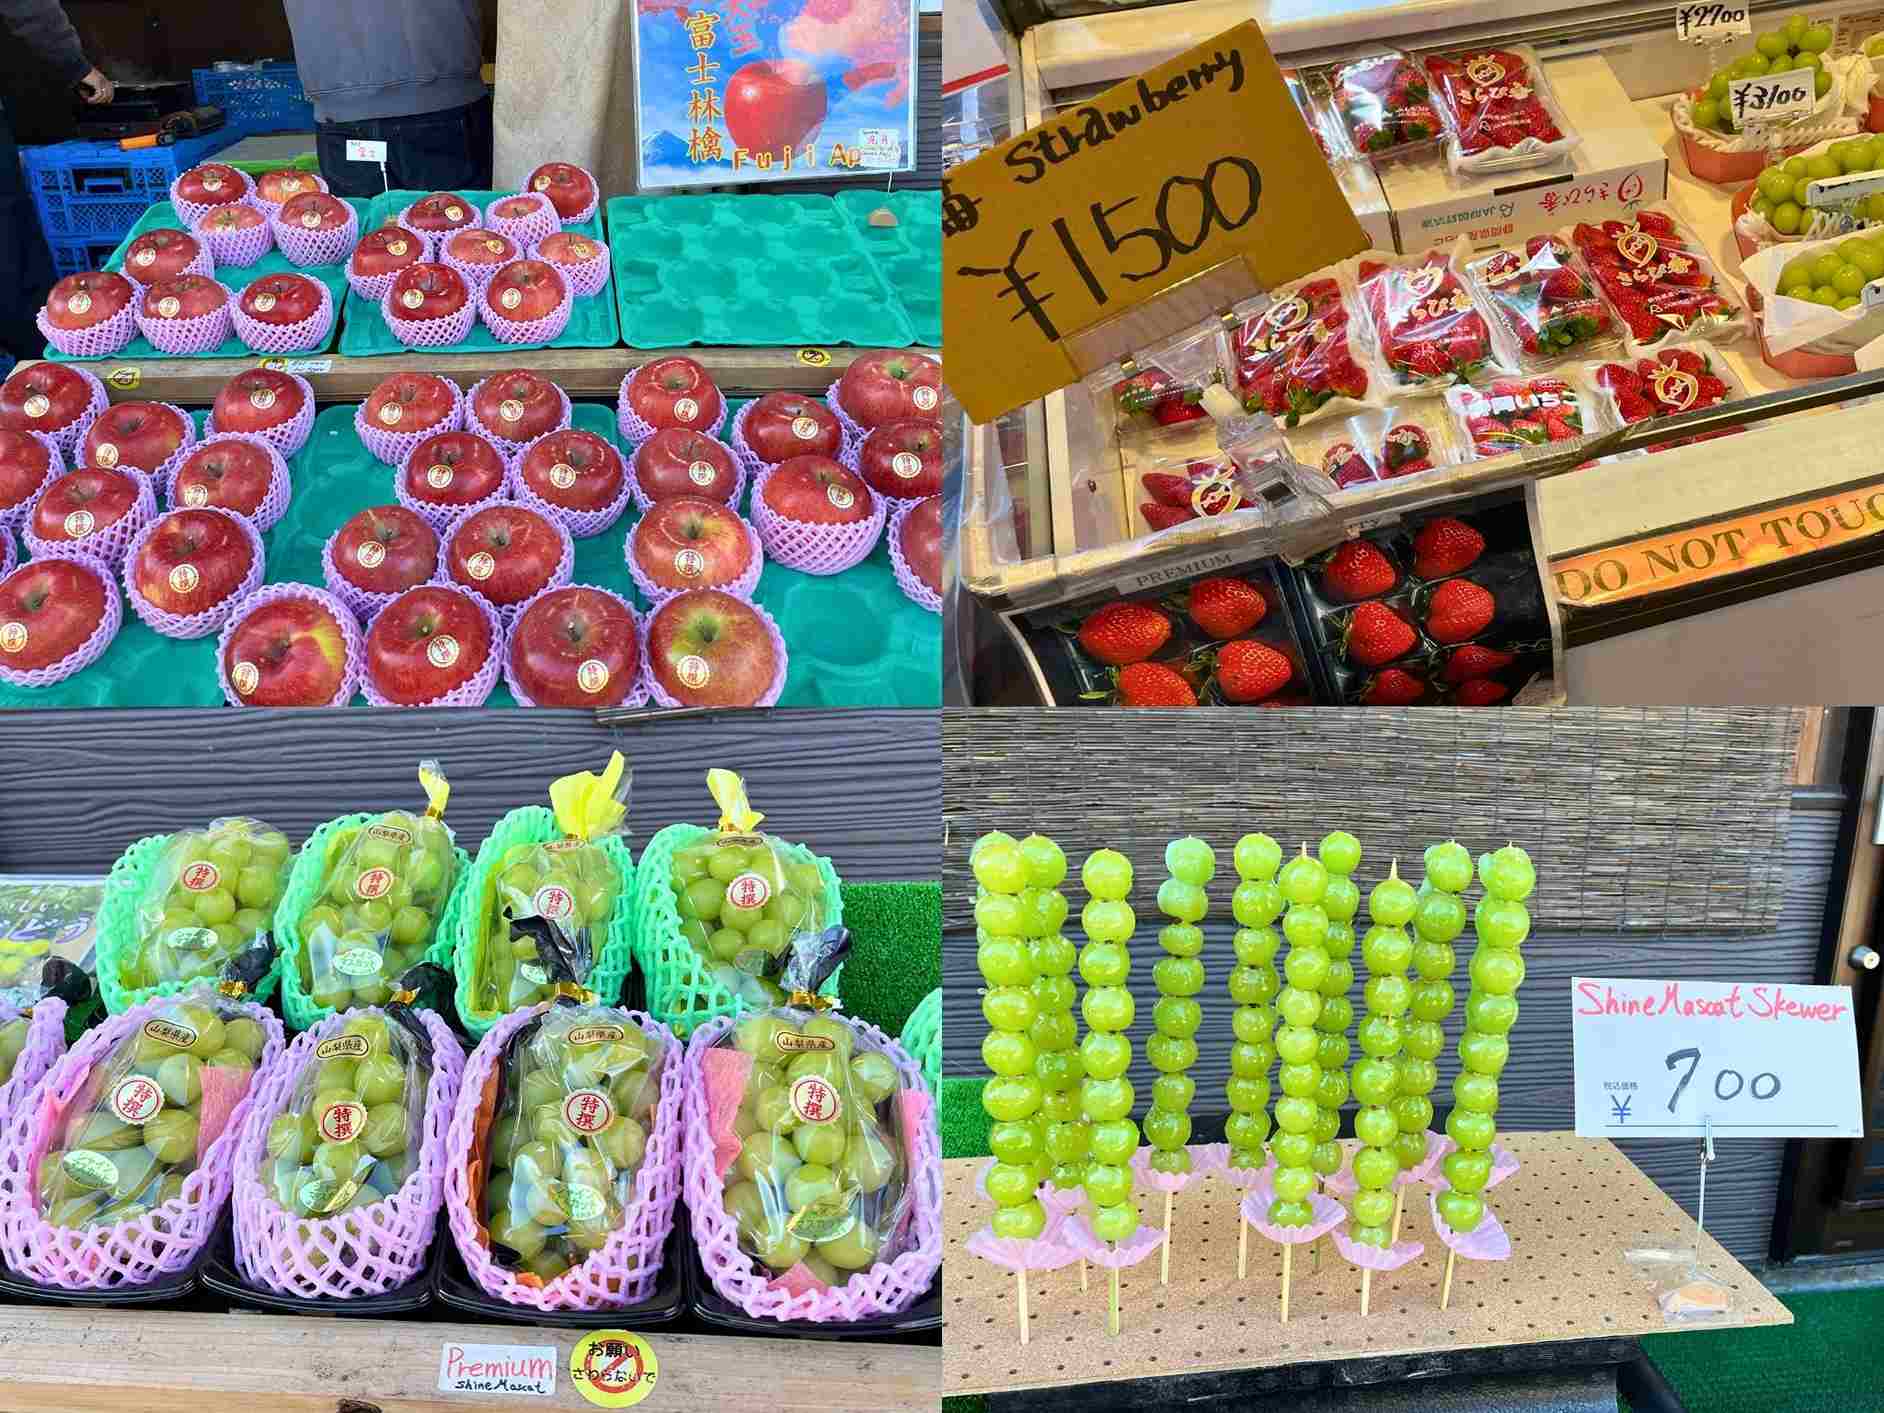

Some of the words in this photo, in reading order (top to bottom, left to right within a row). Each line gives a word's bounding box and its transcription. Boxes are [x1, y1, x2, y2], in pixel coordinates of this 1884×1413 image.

[685, 11, 723, 163] 富士林檎
[1733, 83, 1807, 119] ¥3100
[1004, 49, 1244, 184] Strawberry
[730, 143, 817, 171] Fuji
[956, 155, 1262, 343] ¥1500
[1136, 553, 1233, 587] PREMIUM
[1555, 559, 1629, 602] DO
[1641, 527, 1746, 579] NOT
[1578, 982, 1657, 1017] Shine
[1747, 986, 1849, 1022] Skewer
[1611, 1094, 1632, 1124] ¥
[1664, 1047, 1782, 1114] 700
[447, 1346, 553, 1380] Premium
[588, 1340, 640, 1358] お願い
